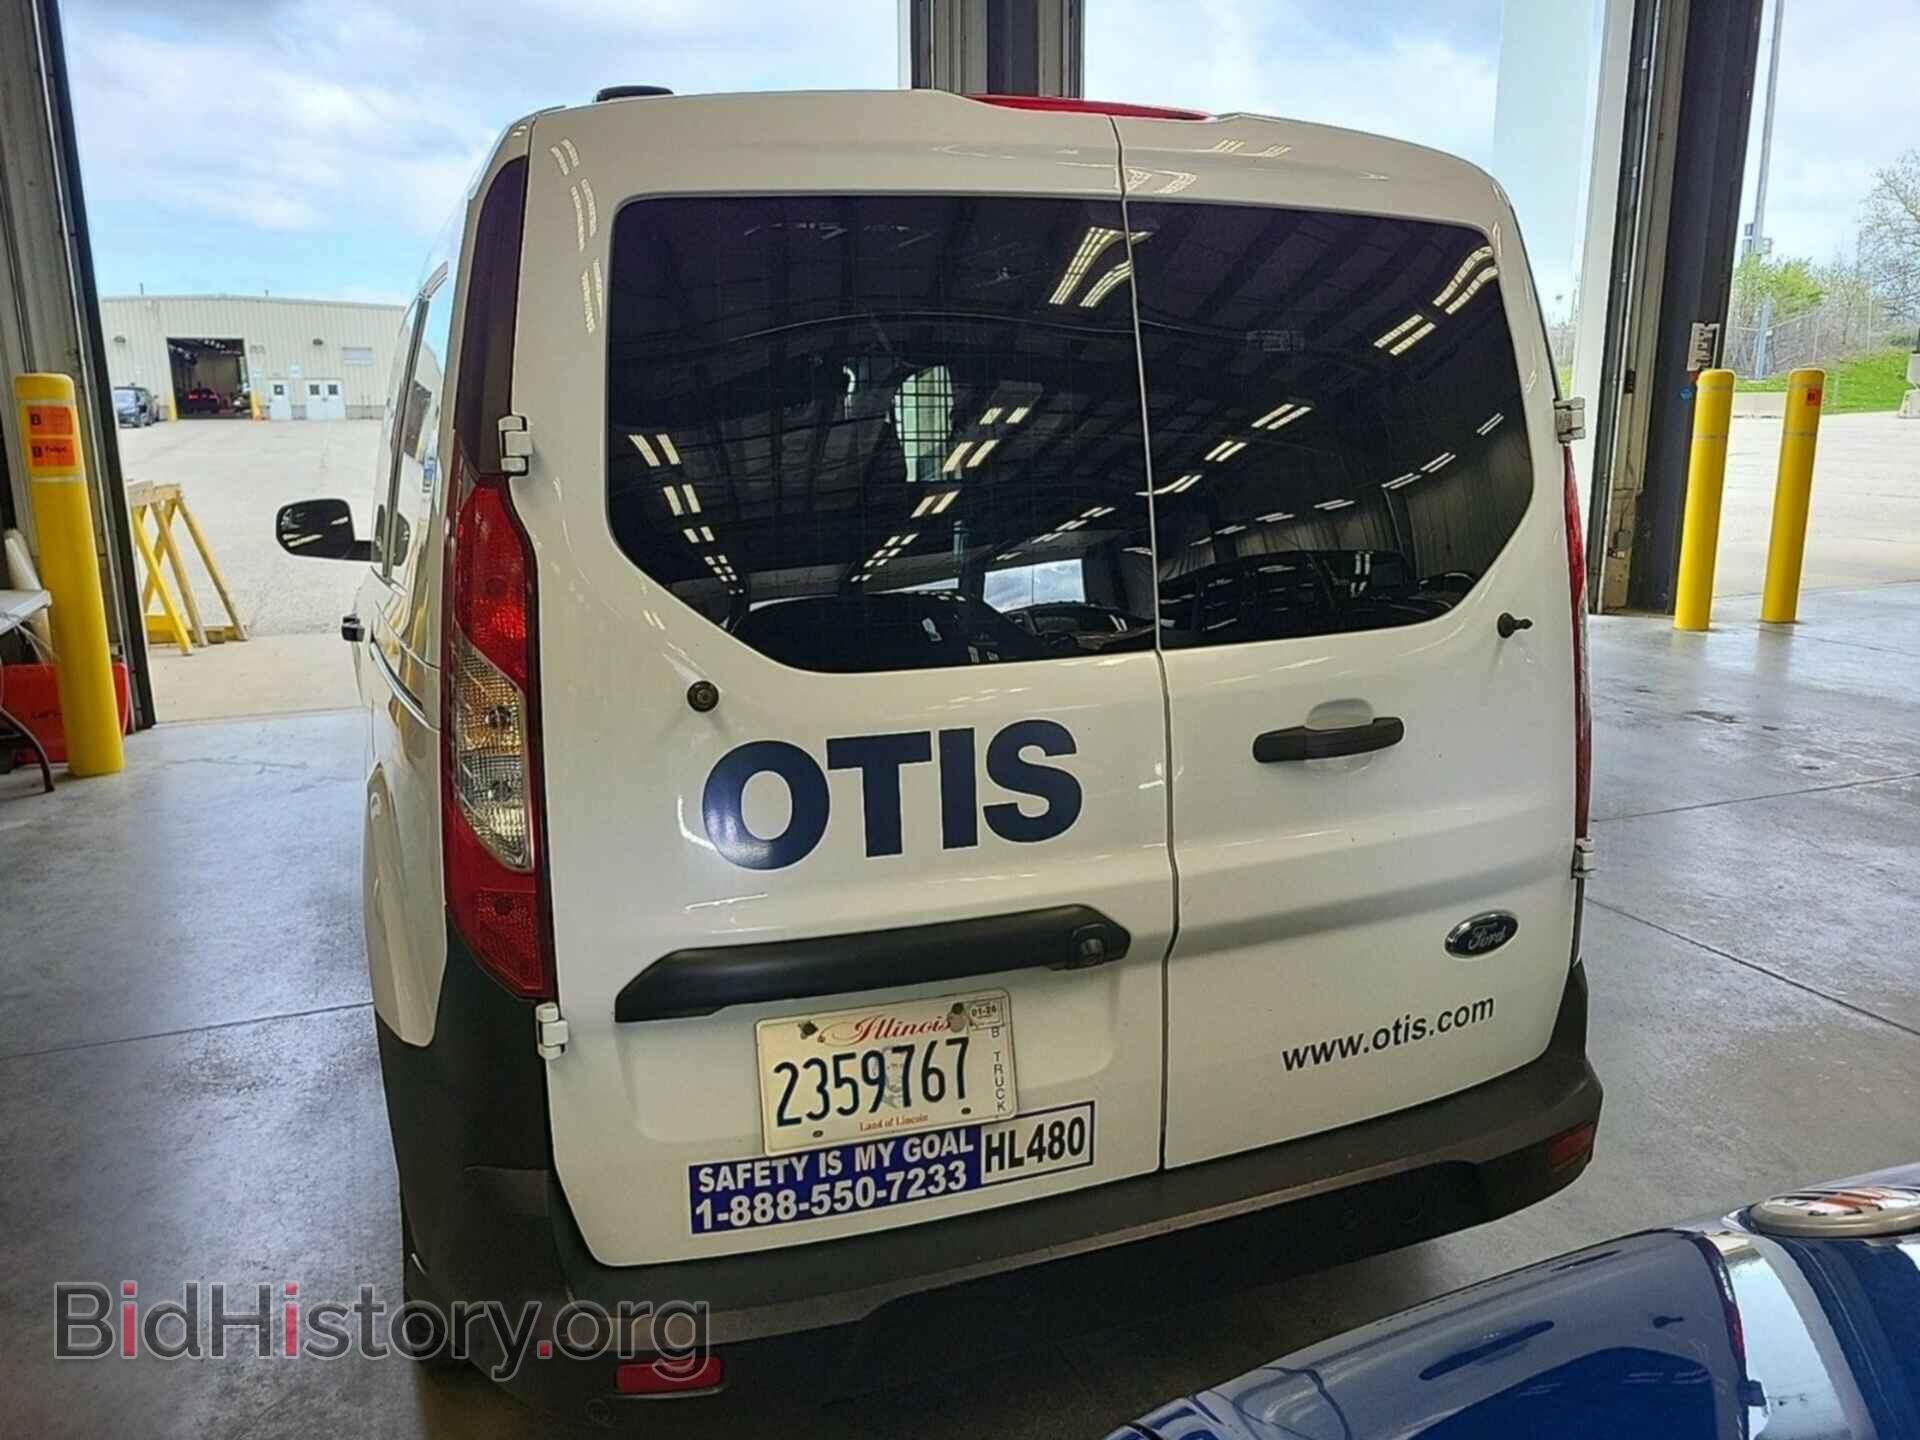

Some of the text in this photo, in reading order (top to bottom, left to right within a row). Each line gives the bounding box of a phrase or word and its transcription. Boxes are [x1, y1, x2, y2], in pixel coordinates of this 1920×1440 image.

[702, 718, 1083, 871] OTIS
[817, 1014, 952, 1047] Illinois
[1281, 996, 1495, 1072] www.otis.com
[772, 1036, 970, 1129] 2359767
[991, 1026, 1006, 1113] B TRUCK
[859, 1112, 929, 1132] Land of Lincoln
[985, 1116, 1086, 1174] HL480
[695, 1160, 968, 1230] 1-888-550-7233
[698, 1127, 974, 1193] SAFETY IS MY GOAL
